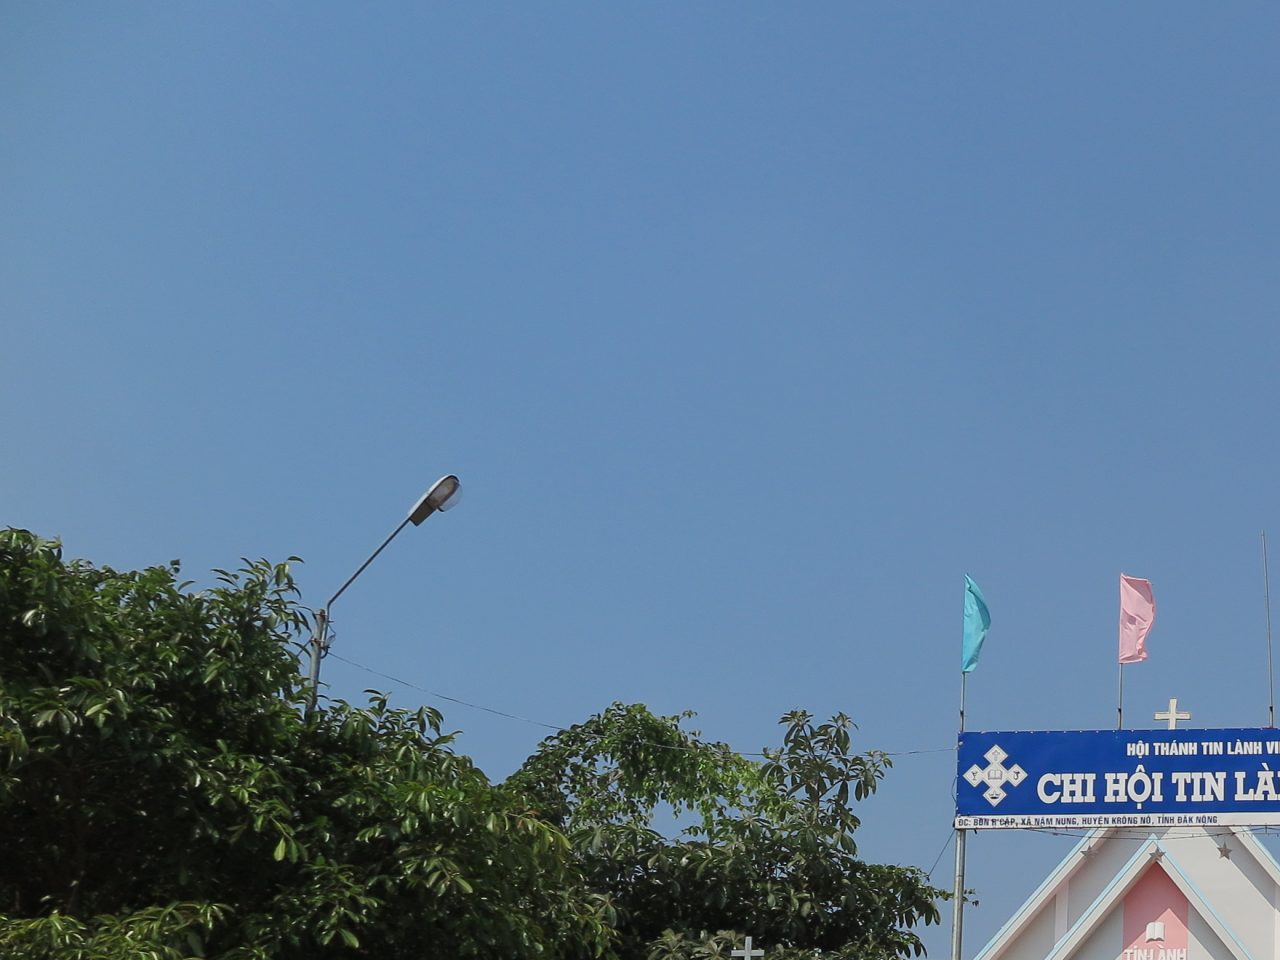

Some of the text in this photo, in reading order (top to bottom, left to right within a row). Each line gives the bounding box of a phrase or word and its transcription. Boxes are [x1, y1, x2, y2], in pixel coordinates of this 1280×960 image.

[1126, 740, 1149, 759] HỘI
[1153, 740, 1197, 756] THÁNH
[1201, 742, 1224, 755] TIN
[1227, 739, 1262, 755] LÀNH
[1037, 773, 1096, 804] CHI
[1104, 764, 1163, 809] HỘI
[1171, 772, 1226, 802] TIN
